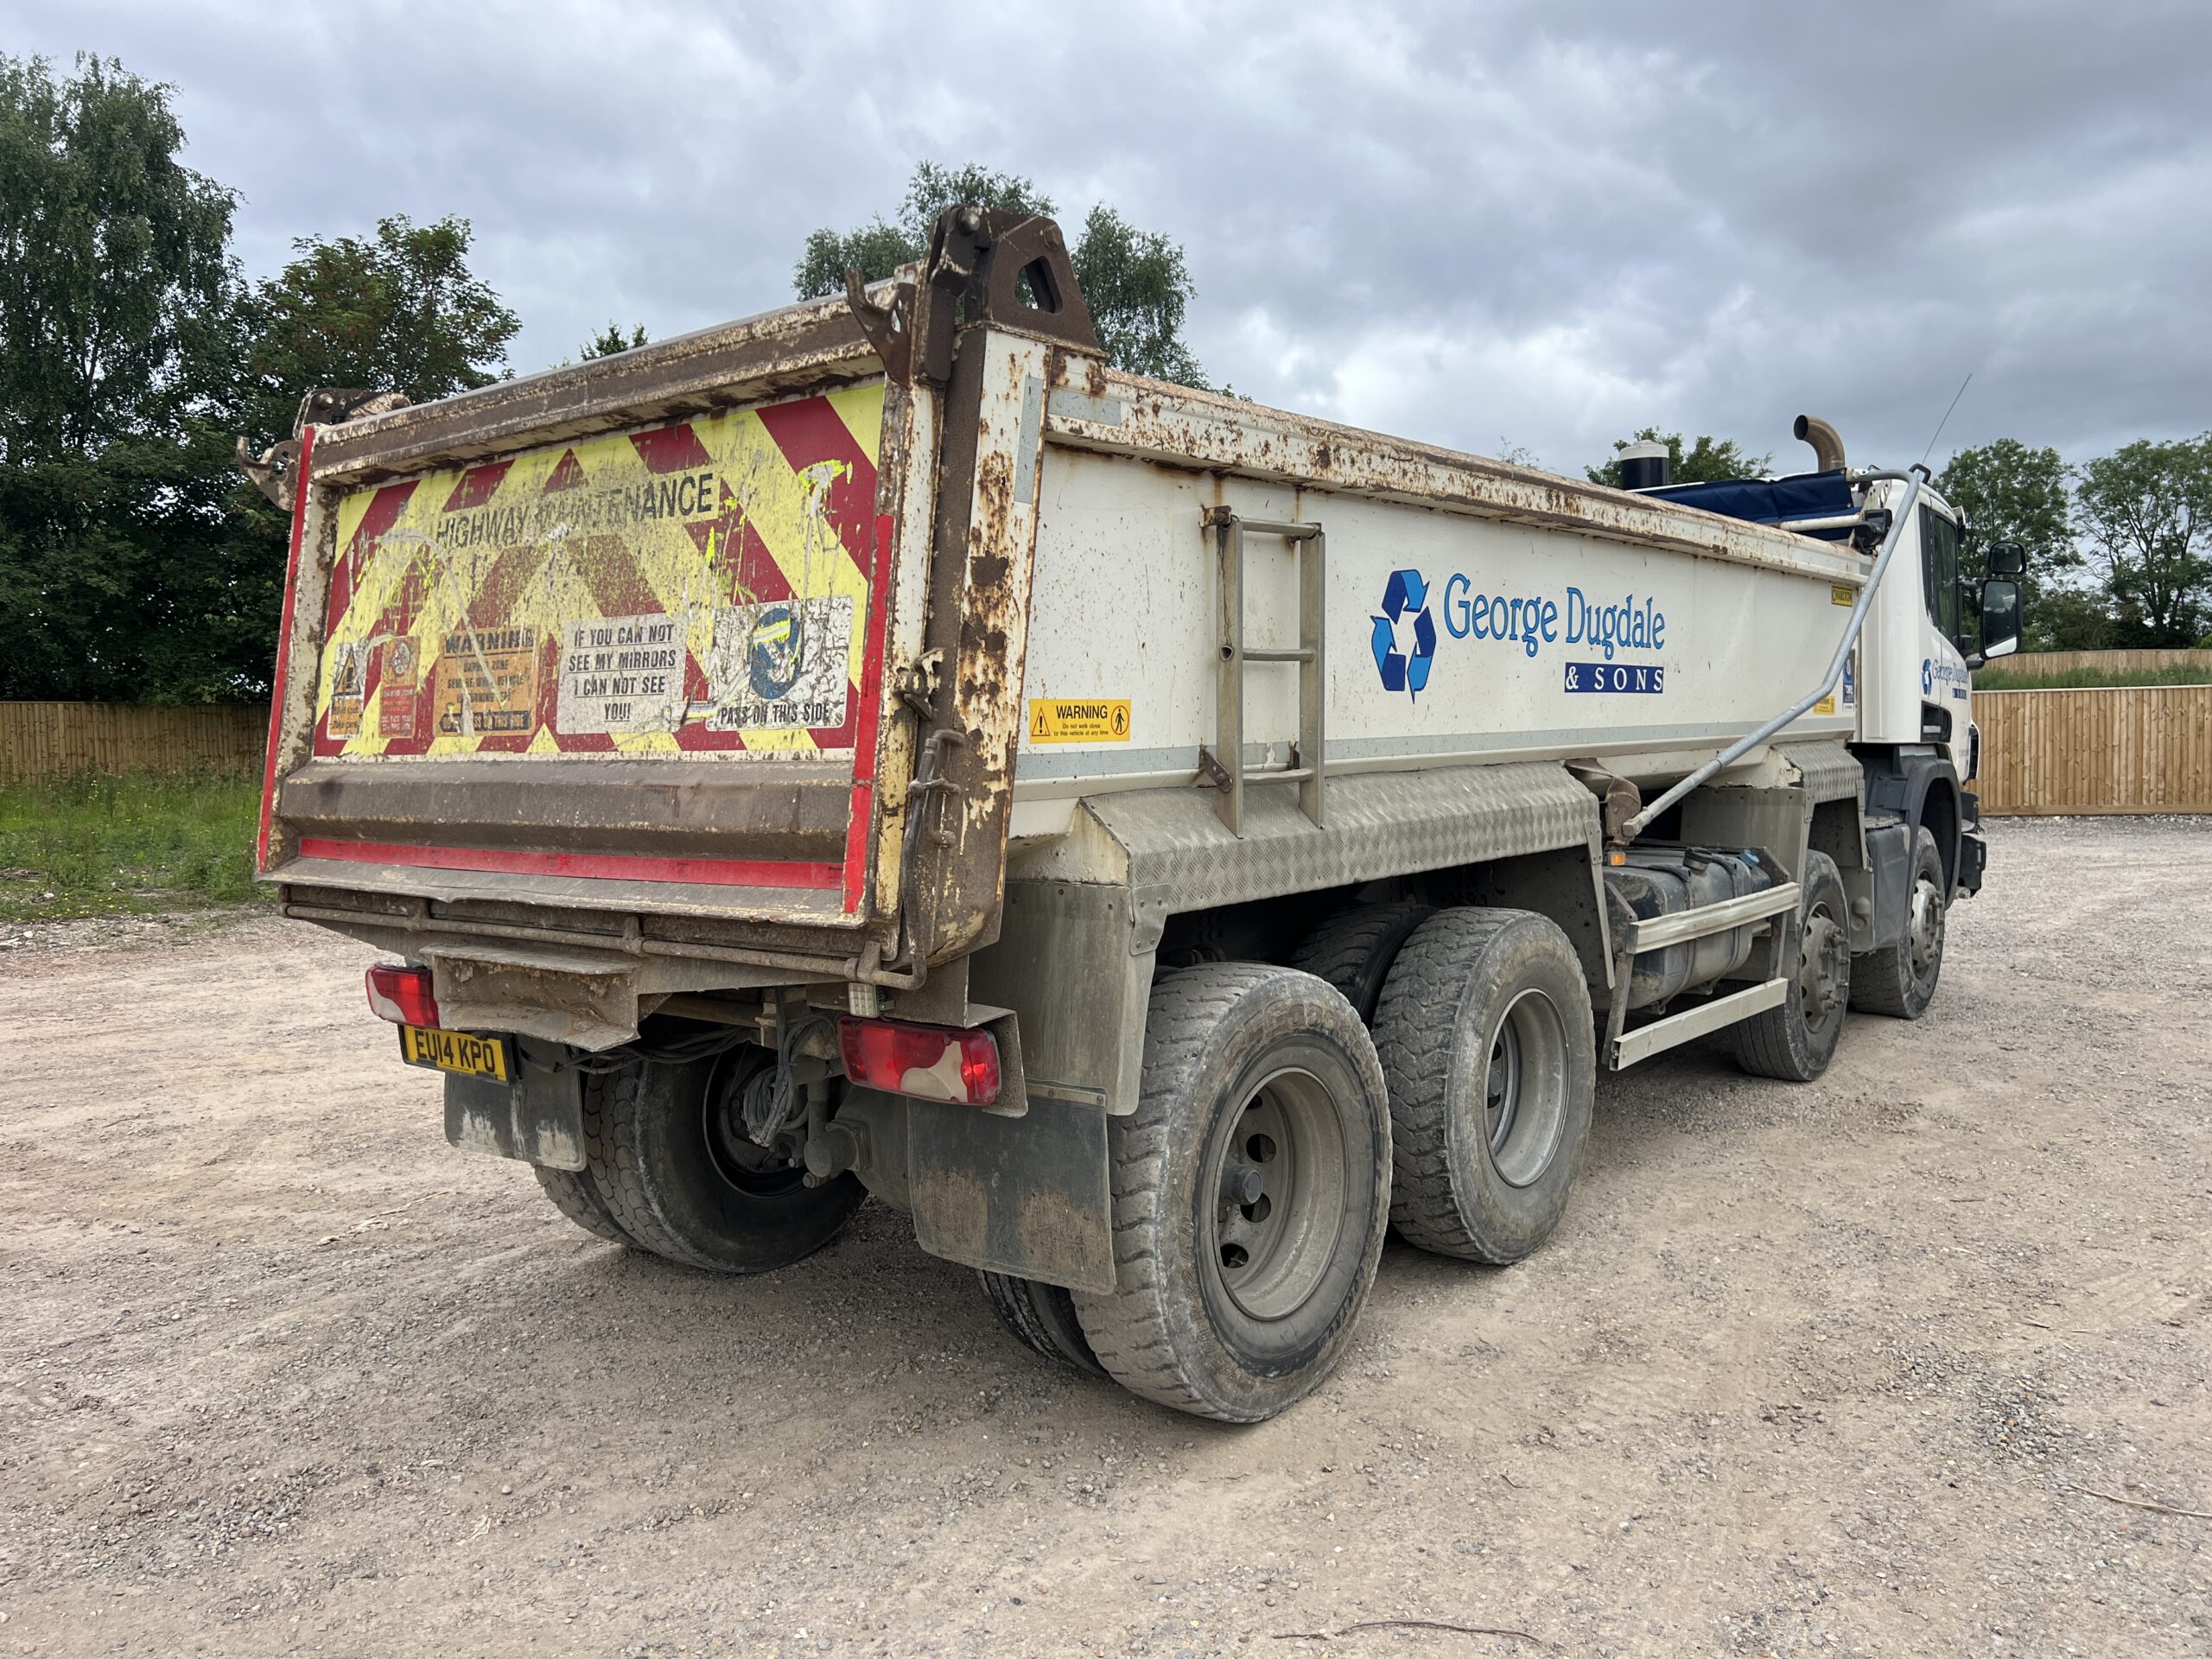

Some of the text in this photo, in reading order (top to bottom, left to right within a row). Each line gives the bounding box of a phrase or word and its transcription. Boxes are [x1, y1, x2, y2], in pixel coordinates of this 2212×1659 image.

[435, 505, 528, 548] HIGHWAY
[1443, 572, 1666, 660] George Dugdale
[574, 624, 675, 647] IF YOU CAN NOT
[569, 650, 677, 672] SEE MY MIRRORS
[583, 678, 607, 696] CAN
[612, 677, 637, 695] NOT
[641, 676, 666, 694] SEE
[1565, 665, 1663, 691] & SONS
[720, 702, 830, 725] PASS ON THIS SIDE
[1056, 704, 1108, 720] WARNING
[415, 1029, 454, 1065] EU14
